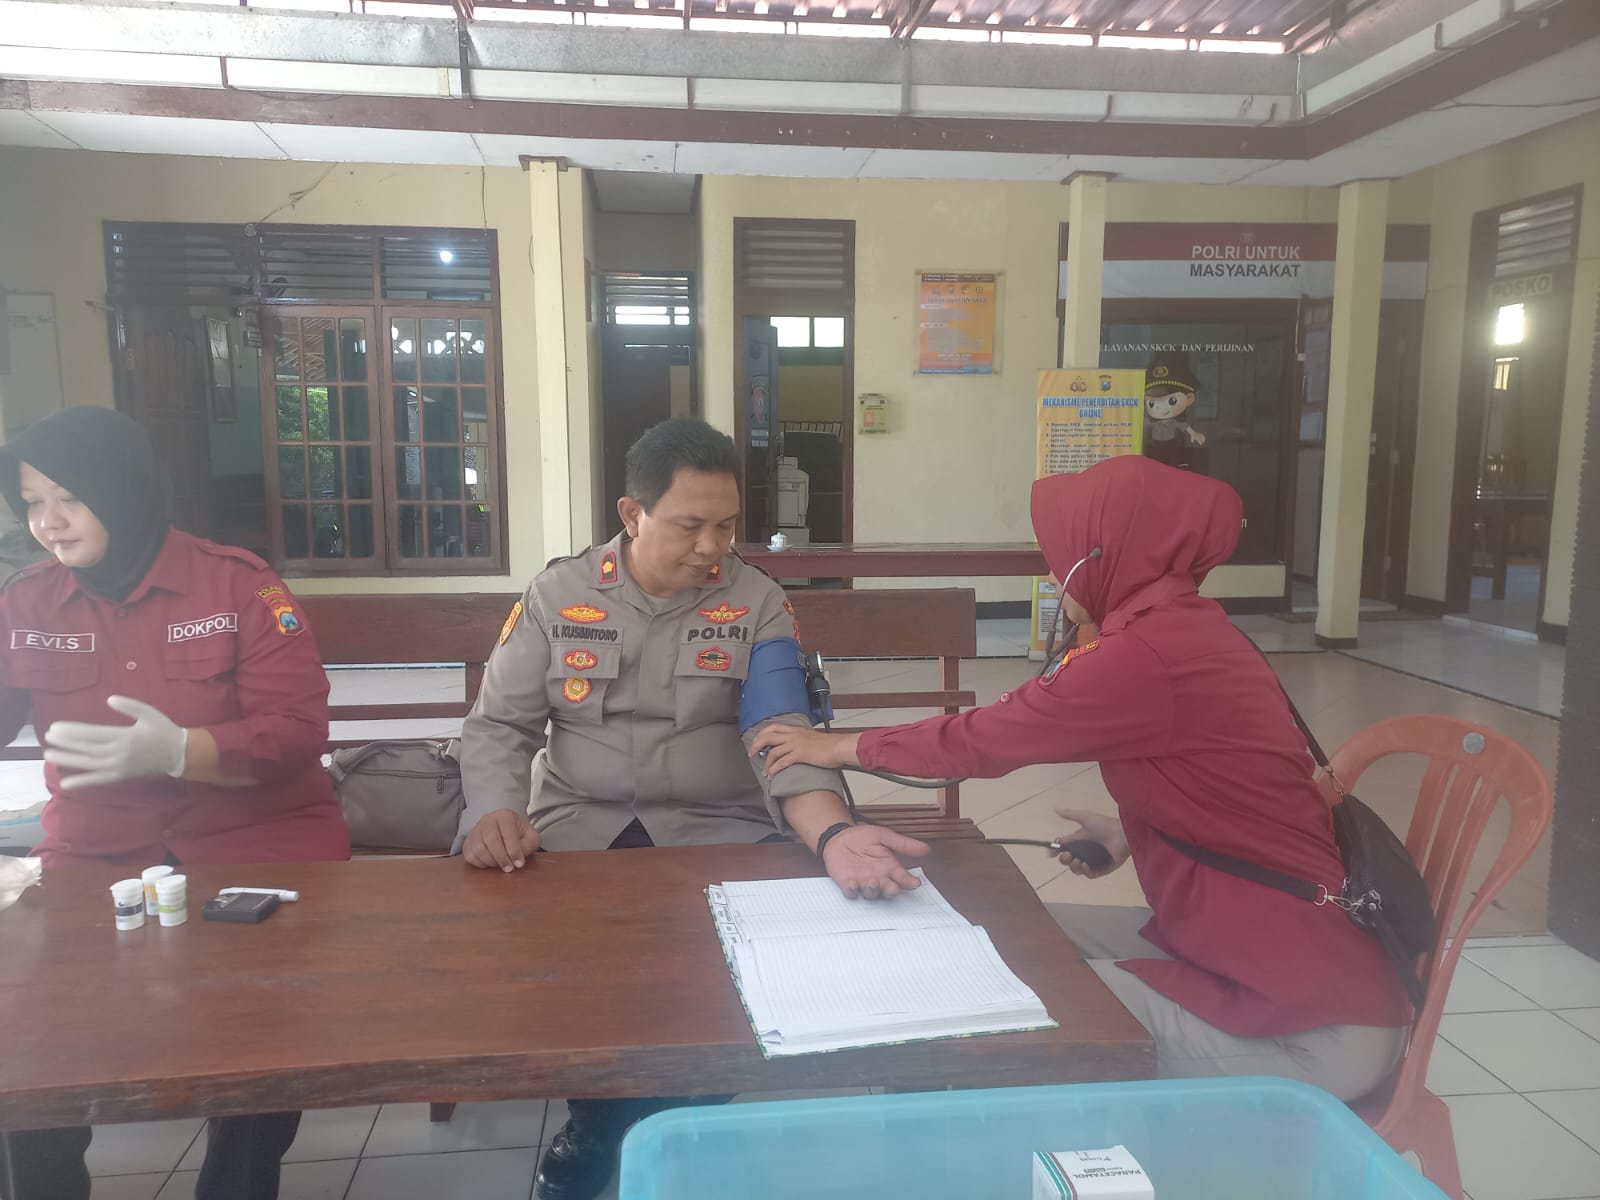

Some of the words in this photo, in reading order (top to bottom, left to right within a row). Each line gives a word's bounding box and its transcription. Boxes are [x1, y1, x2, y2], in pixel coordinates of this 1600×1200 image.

[1191, 245, 1241, 259] POLRI
[1244, 246, 1301, 260] UNTUK
[1189, 263, 1302, 278] MASYARAKAT
[1492, 276, 1549, 299] POSKO
[1099, 343, 1149, 353] ELAYANAN
[1150, 343, 1176, 353] SKCK
[1182, 343, 1201, 352] DAN
[1206, 343, 1255, 353] PERIJINAN
[173, 616, 236, 640] DOKPOL
[687, 625, 748, 642] POLRI
[26, 633, 80, 650] EVI.S
[1072, 1168, 1142, 1179] PARACETAMOL
